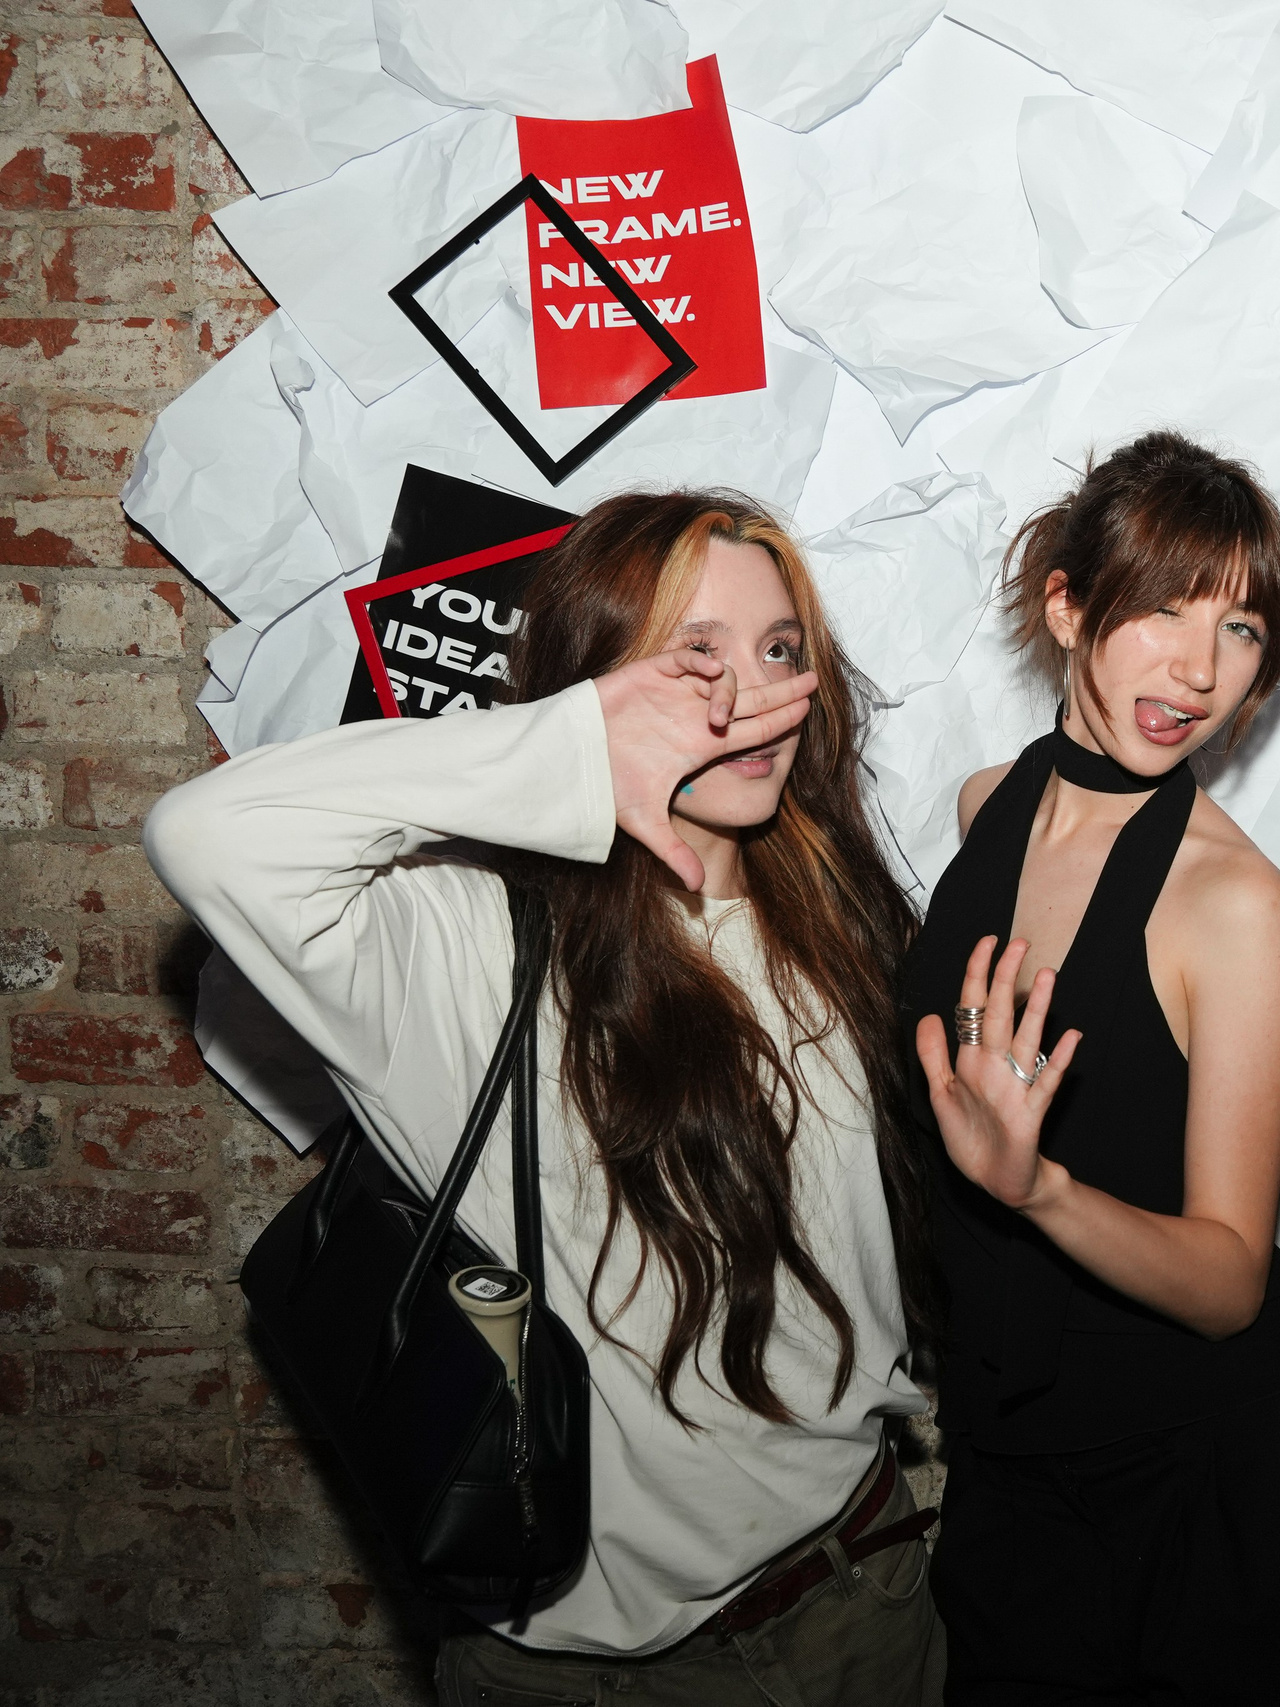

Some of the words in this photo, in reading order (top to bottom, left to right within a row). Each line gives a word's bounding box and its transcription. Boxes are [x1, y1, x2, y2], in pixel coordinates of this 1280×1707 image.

[539, 169, 664, 205] NEW
[538, 201, 742, 248] FRAME.
[544, 295, 696, 330] VIEW.
[411, 582, 530, 641] YOU
[373, 667, 505, 715] STA
